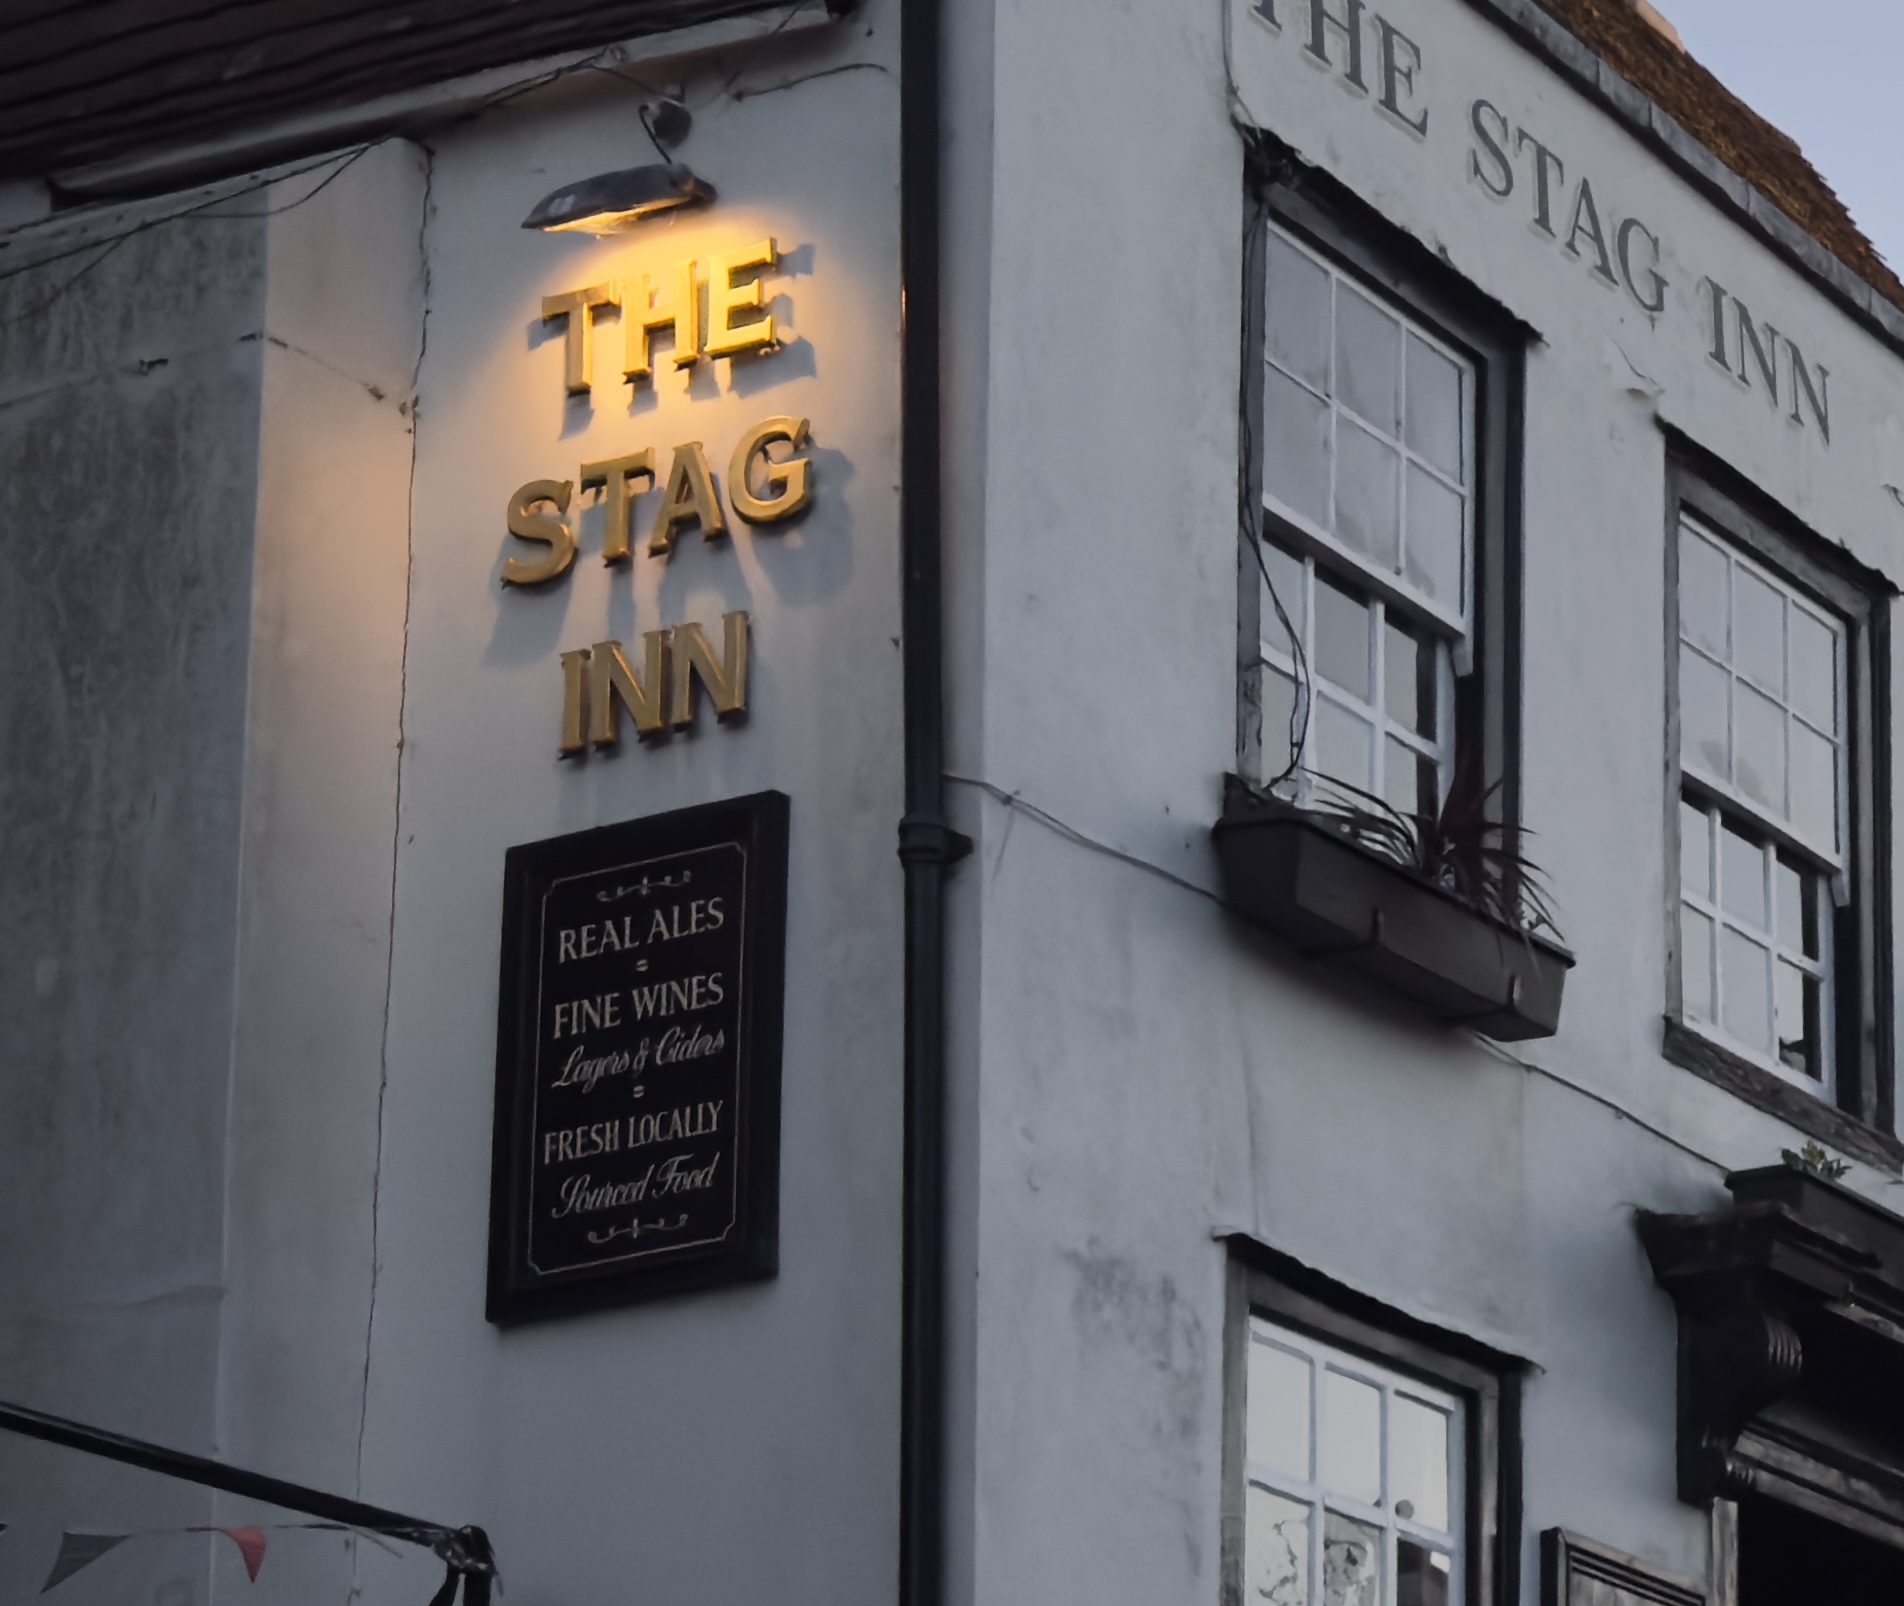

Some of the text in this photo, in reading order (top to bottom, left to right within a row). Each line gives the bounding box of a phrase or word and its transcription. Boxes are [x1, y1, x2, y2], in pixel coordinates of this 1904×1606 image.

[1252, 0, 1831, 446] HE STAG INN
[541, 237, 778, 398] THE
[502, 415, 813, 588] STAG
[558, 611, 750, 759] INN
[559, 897, 724, 964] REAL ALES
[554, 972, 724, 1039] FINE WINES
[552, 1045, 630, 1094] Lagers
[655, 1025, 725, 1066] Ciders
[544, 1100, 723, 1165] FRESH LOCALLY
[552, 1152, 720, 1218] Sourced Food
